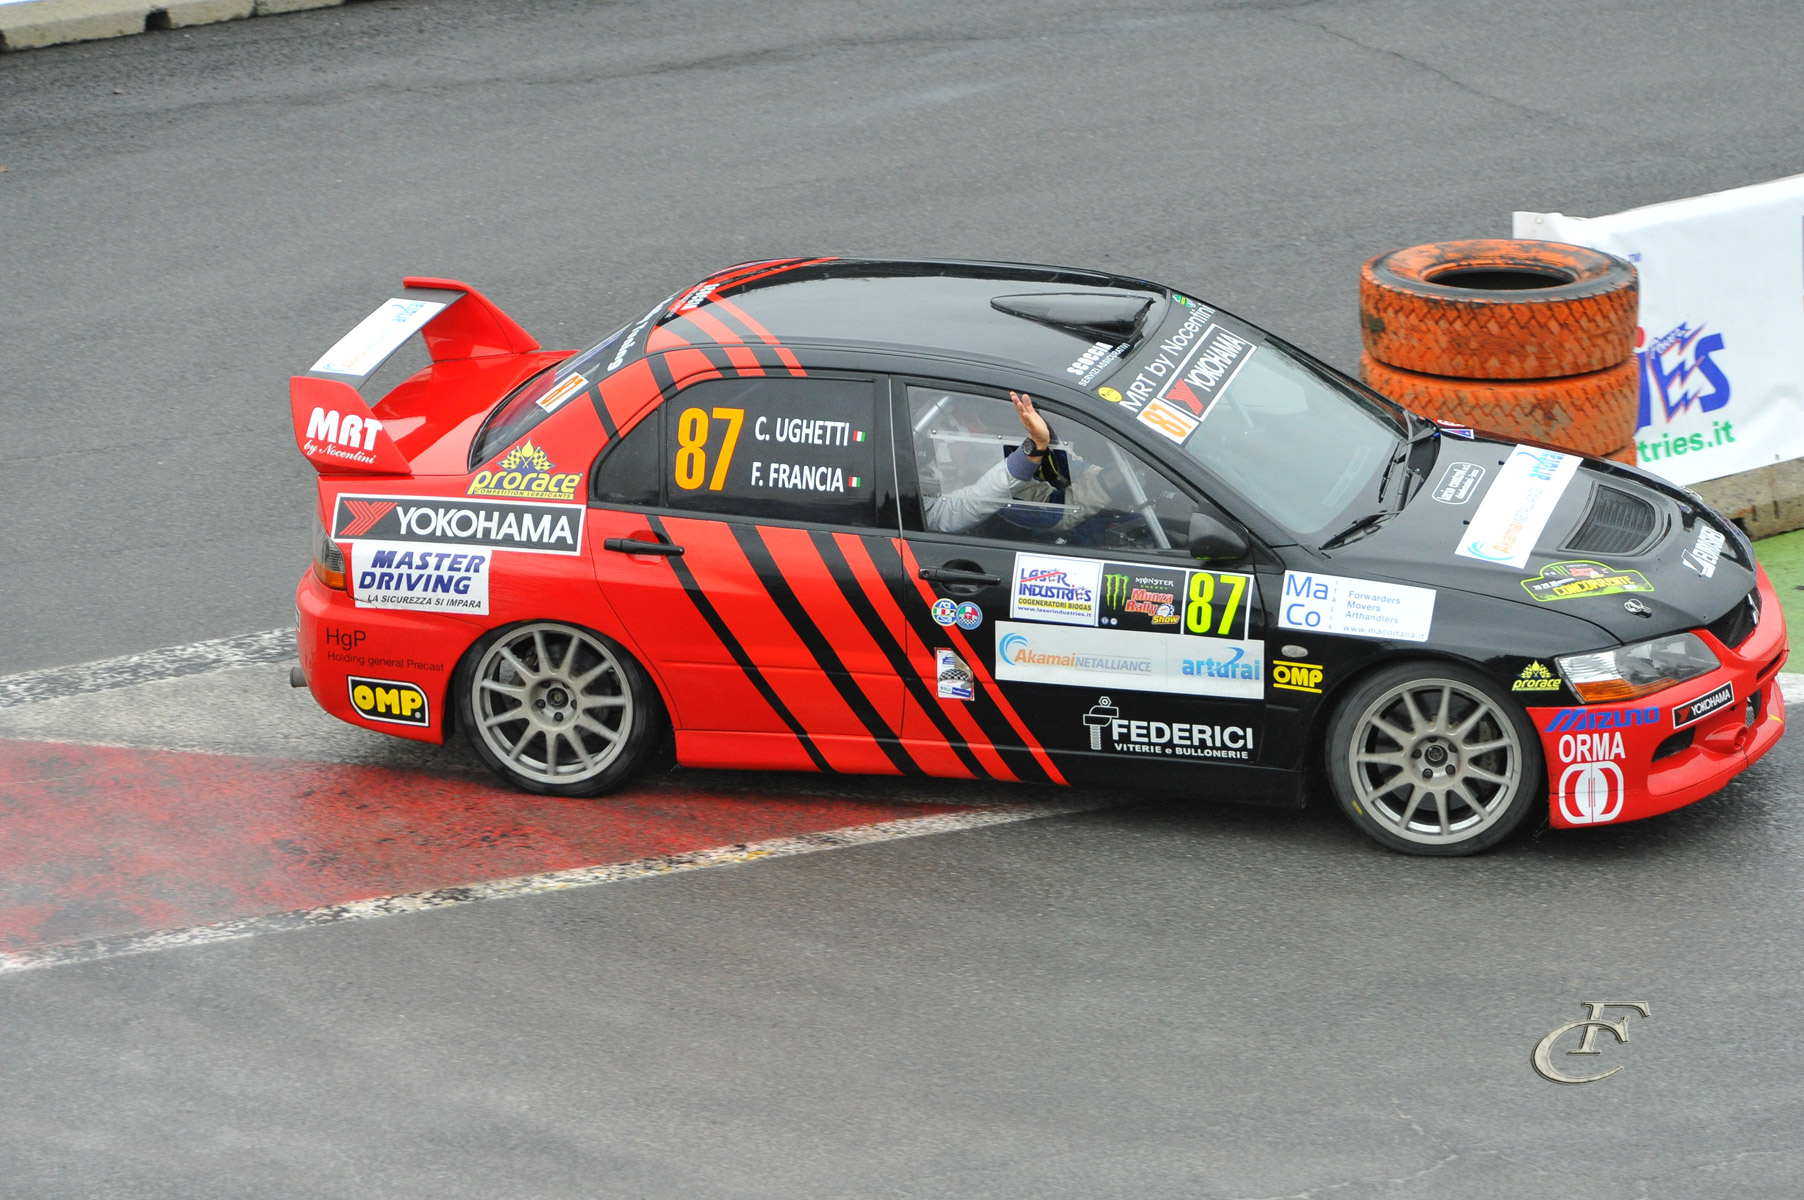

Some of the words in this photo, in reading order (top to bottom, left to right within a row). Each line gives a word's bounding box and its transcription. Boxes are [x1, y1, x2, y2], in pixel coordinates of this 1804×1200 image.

[1119, 373, 1157, 412] MRT
[1145, 353, 1175, 378] by
[1160, 302, 1216, 356] Nocentini
[1184, 332, 1247, 392] YOKOHAMA
[306, 407, 382, 451] MRT
[755, 416, 770, 440] C.
[775, 417, 849, 447] UGHETTI
[1142, 402, 1192, 438] 87
[304, 440, 317, 455] by
[319, 443, 377, 464] Nocentini
[675, 407, 745, 491] 87
[467, 471, 581, 495] prorace
[751, 462, 764, 486] F.
[769, 463, 844, 493] FRANCIA
[475, 488, 524, 496] COMPETITION
[527, 491, 570, 499] LUBRICANTS
[396, 506, 573, 544] YOKOHAMA
[371, 550, 485, 573] MASTER
[359, 571, 471, 595] DRIVING
[1020, 568, 1070, 587] LASER
[1135, 577, 1174, 588] MONSTER
[1286, 574, 1329, 600] Ma
[1553, 576, 1635, 596] CONCORRENTE
[367, 594, 379, 602] LA
[381, 595, 432, 606] SICUREZZA
[434, 598, 444, 606] SI
[446, 599, 481, 608] IMPARA
[1019, 583, 1091, 602] INDUSTRIES
[1131, 588, 1173, 604] Monza
[1186, 572, 1246, 635] 87
[1349, 591, 1400, 605] Forwarders
[1017, 606, 1091, 617] www.laserindustries.it
[1018, 598, 1066, 609] COGENERATORI
[1068, 603, 1091, 611] BIOGAS
[1125, 600, 1158, 616] Rally
[1286, 603, 1321, 628] Co
[1347, 601, 1381, 612] Movers
[1152, 615, 1180, 625] Show
[1345, 611, 1399, 624] Arthandlers
[326, 627, 366, 651] HgP
[1343, 625, 1425, 640] www.macoitalia.it
[327, 651, 365, 667] Holding
[368, 656, 404, 670] general
[407, 659, 445, 673] Precast
[1013, 649, 1075, 667] Akamai
[1273, 665, 1323, 688] OMP
[1512, 679, 1561, 691] prorace
[353, 684, 423, 717] OMP
[1690, 688, 1731, 716] YOKOHAMA
[1111, 719, 1254, 749] FEDERICI
[1114, 743, 1161, 755] VITERIE
[1165, 747, 1172, 755] e
[1175, 747, 1248, 759] BULLONERIE
[1558, 732, 1626, 762] ORMA
